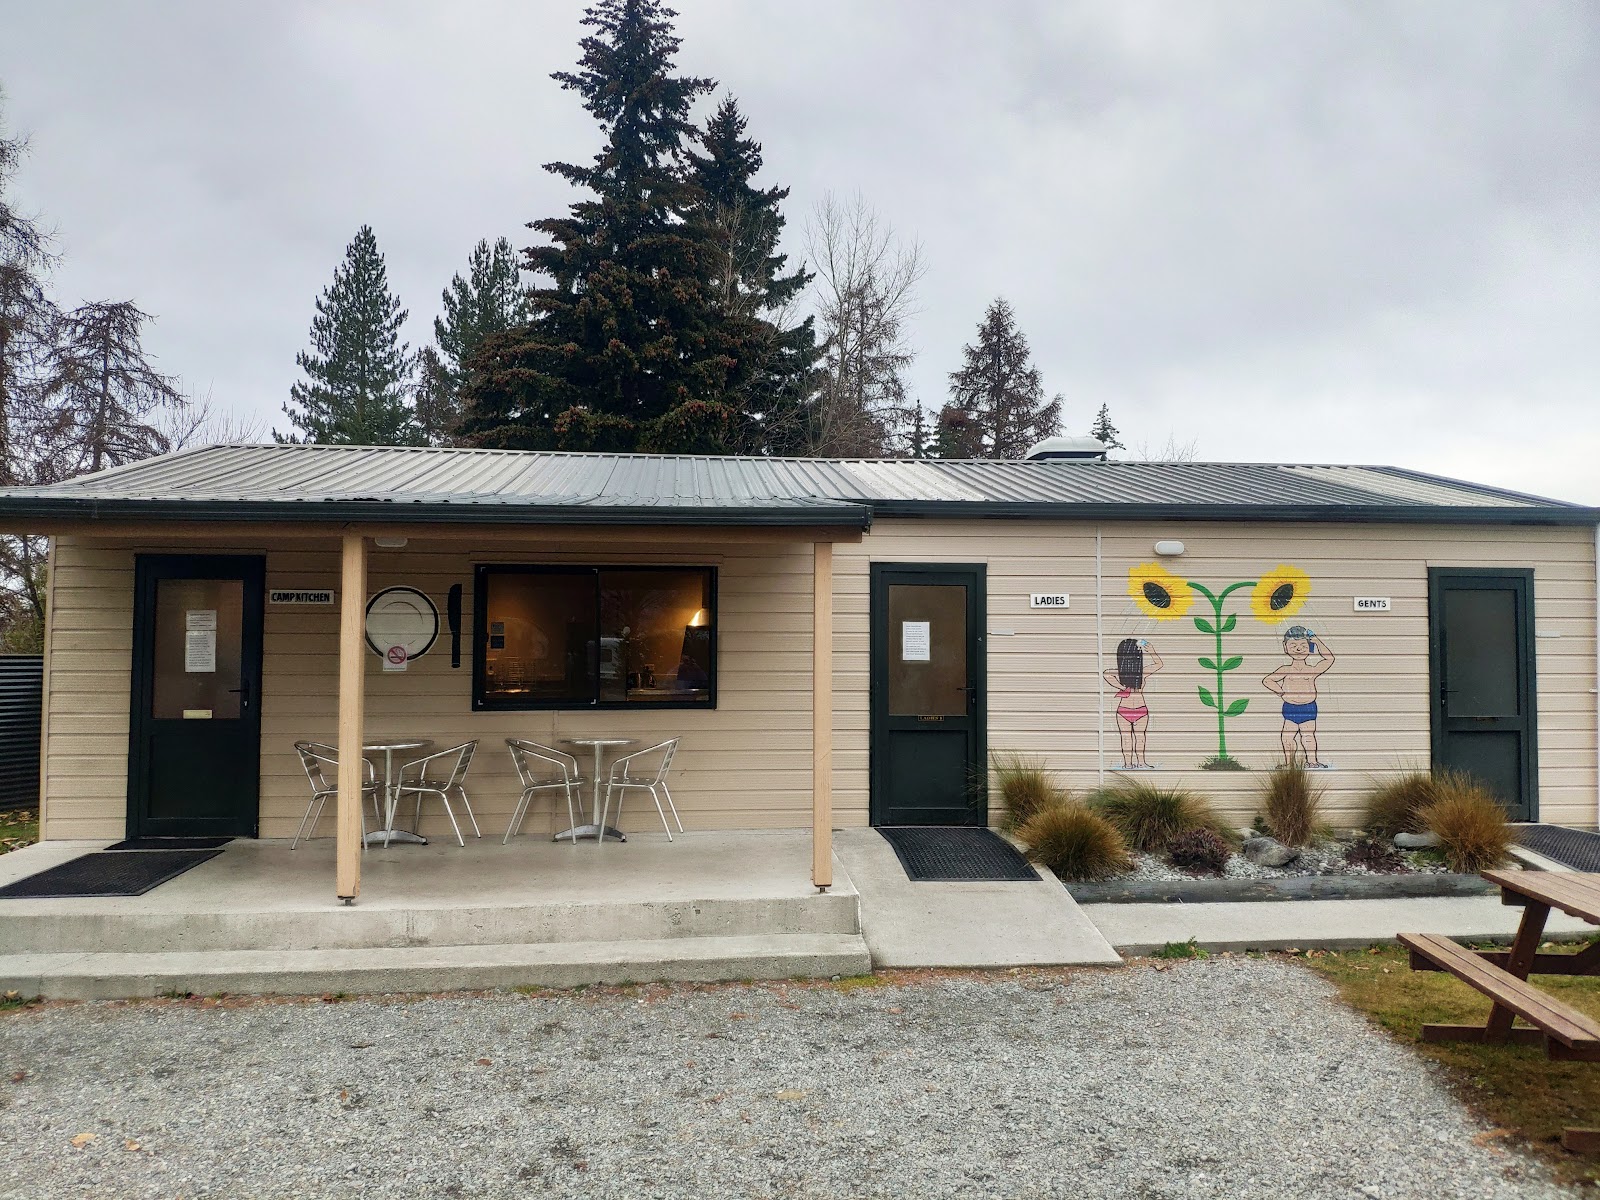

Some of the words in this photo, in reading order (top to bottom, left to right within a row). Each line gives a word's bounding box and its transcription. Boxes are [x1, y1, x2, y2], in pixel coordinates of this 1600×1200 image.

[272, 592, 295, 602] CAMP
[295, 592, 330, 602] KITCHEN
[1035, 596, 1065, 605] LADIES
[1358, 600, 1387, 608] GENTS
